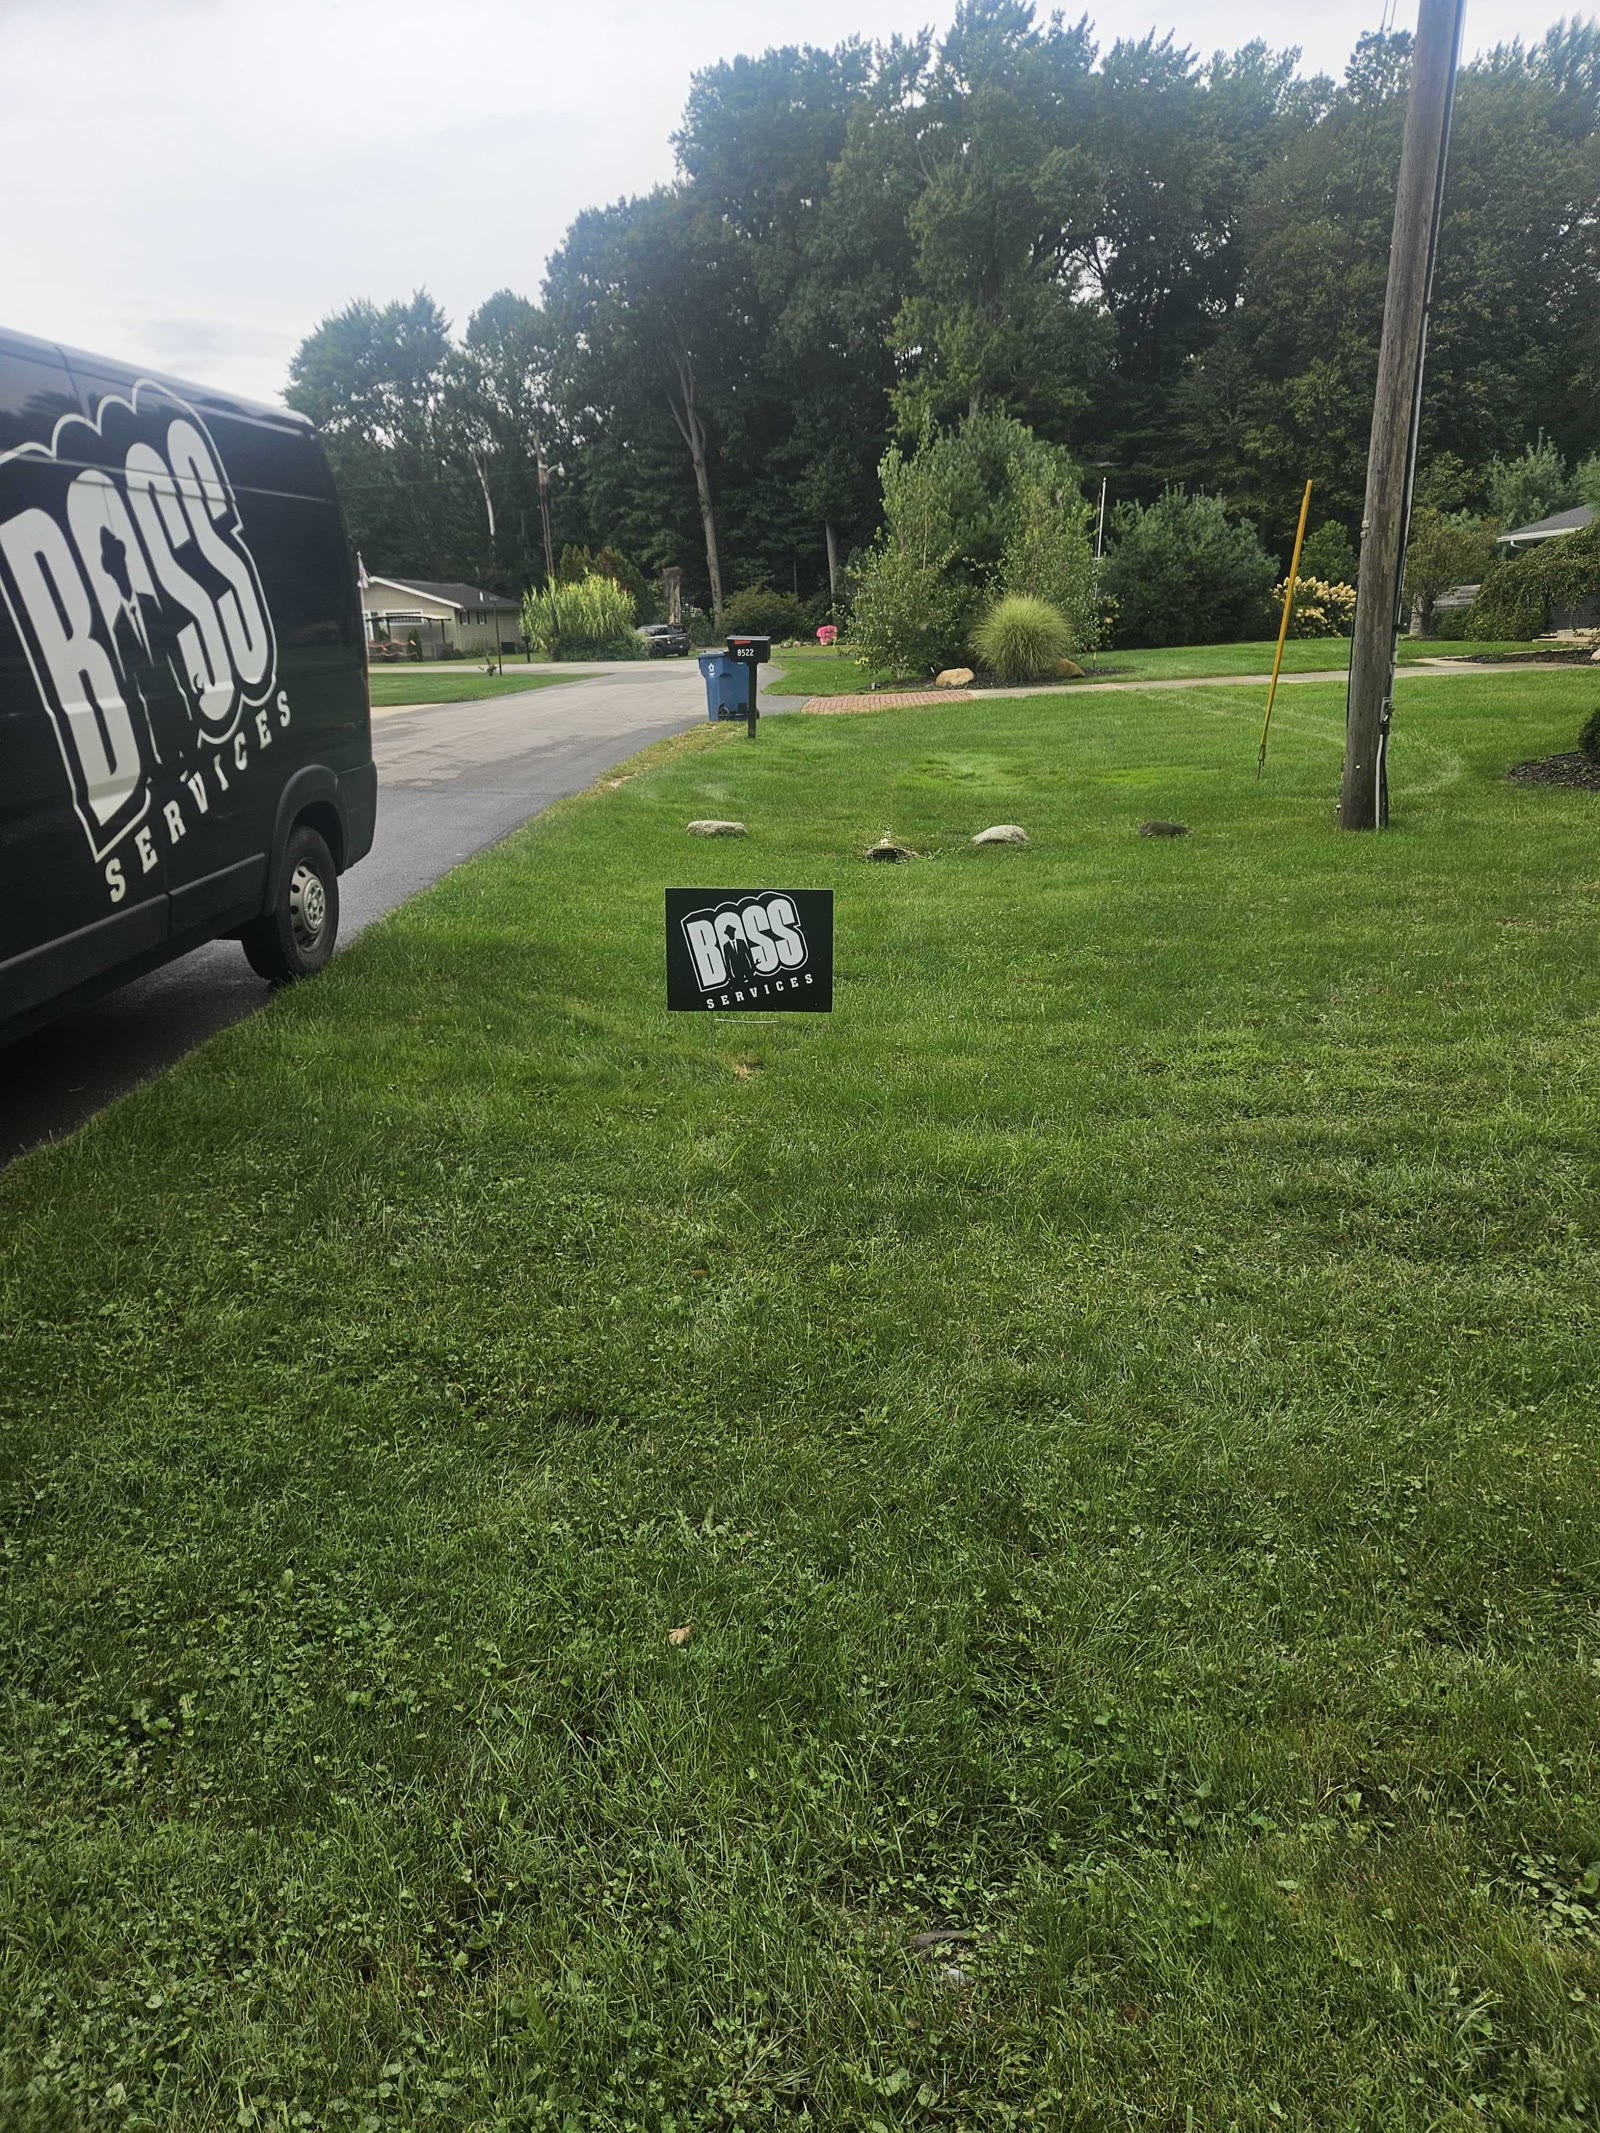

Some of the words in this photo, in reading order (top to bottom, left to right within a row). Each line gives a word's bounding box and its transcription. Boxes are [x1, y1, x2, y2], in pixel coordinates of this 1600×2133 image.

[0, 418, 270, 826] BOSS
[737, 648, 755, 657] 8522
[104, 690, 291, 903] SERVICES
[686, 898, 804, 988] BOSS
[706, 973, 814, 1009] SERVICES
